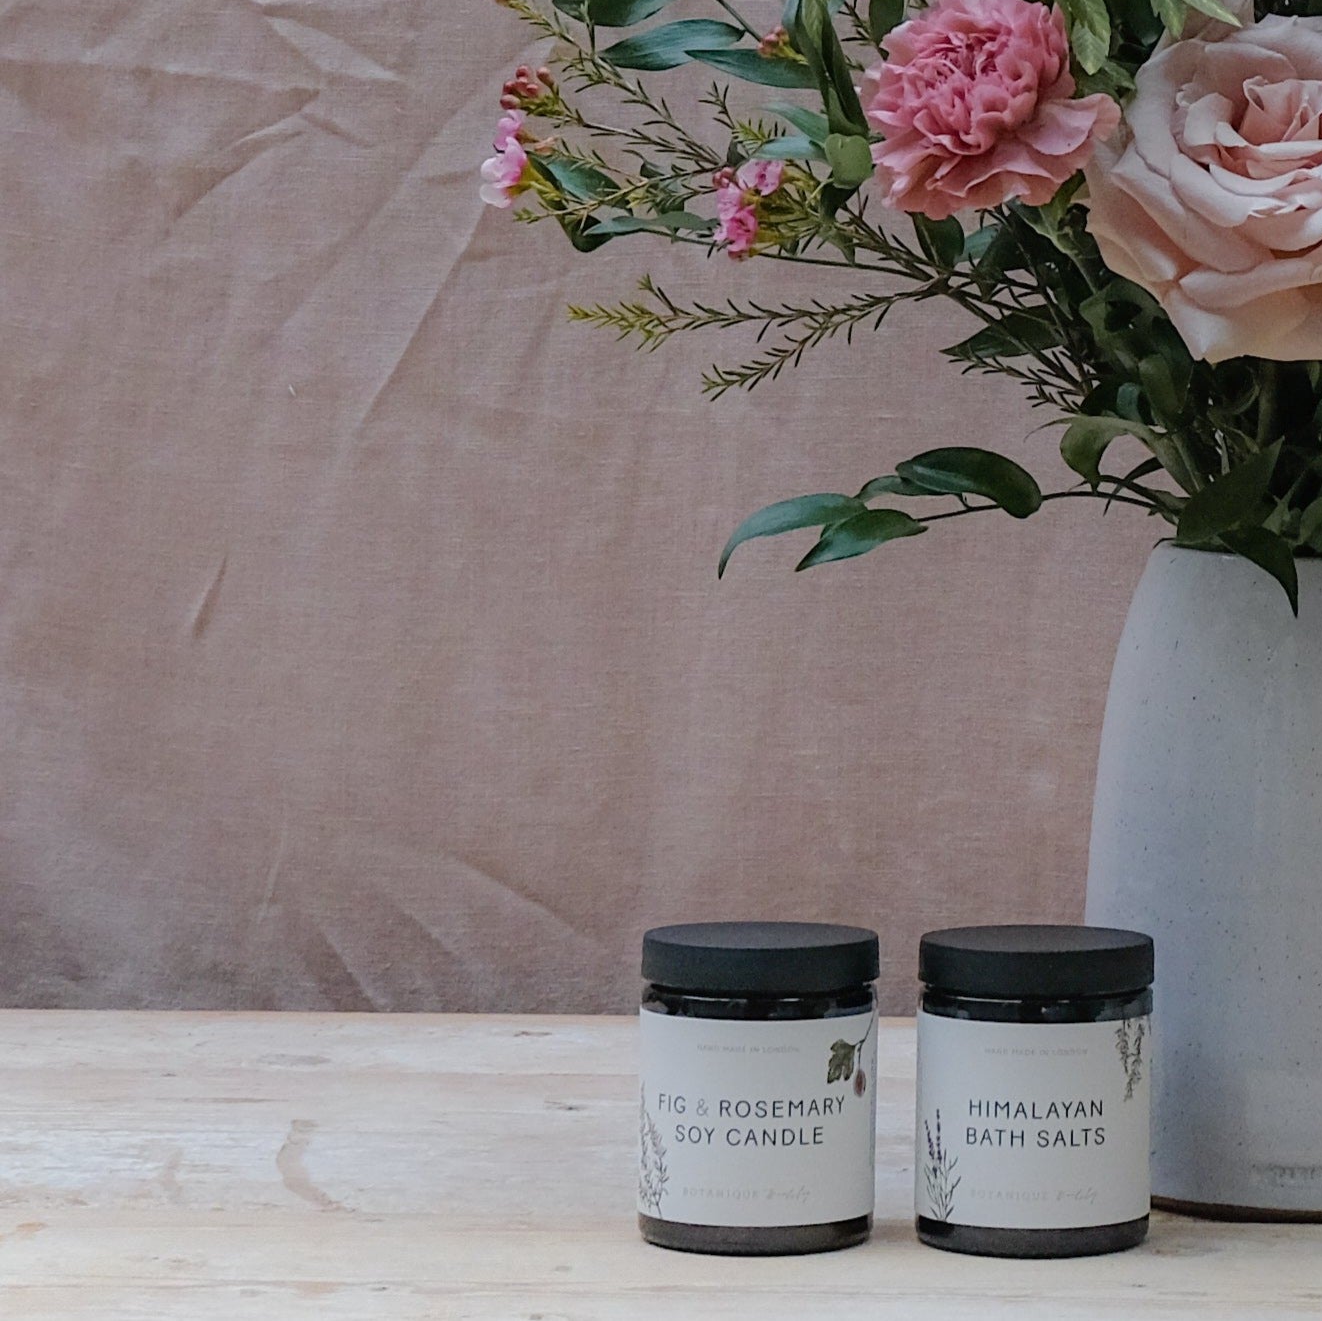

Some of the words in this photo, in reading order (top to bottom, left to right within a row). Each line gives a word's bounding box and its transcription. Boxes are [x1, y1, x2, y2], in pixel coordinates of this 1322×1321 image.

[658, 1093, 686, 1115] FIG
[696, 1099, 709, 1117] &
[719, 1095, 845, 1119] ROSEMARY
[968, 1098, 1104, 1120] HIMALAYAN
[675, 1124, 715, 1145] SOY
[726, 1126, 824, 1147] CANDLE
[966, 1127, 1025, 1148] BATH
[1036, 1127, 1106, 1148] SALTS
